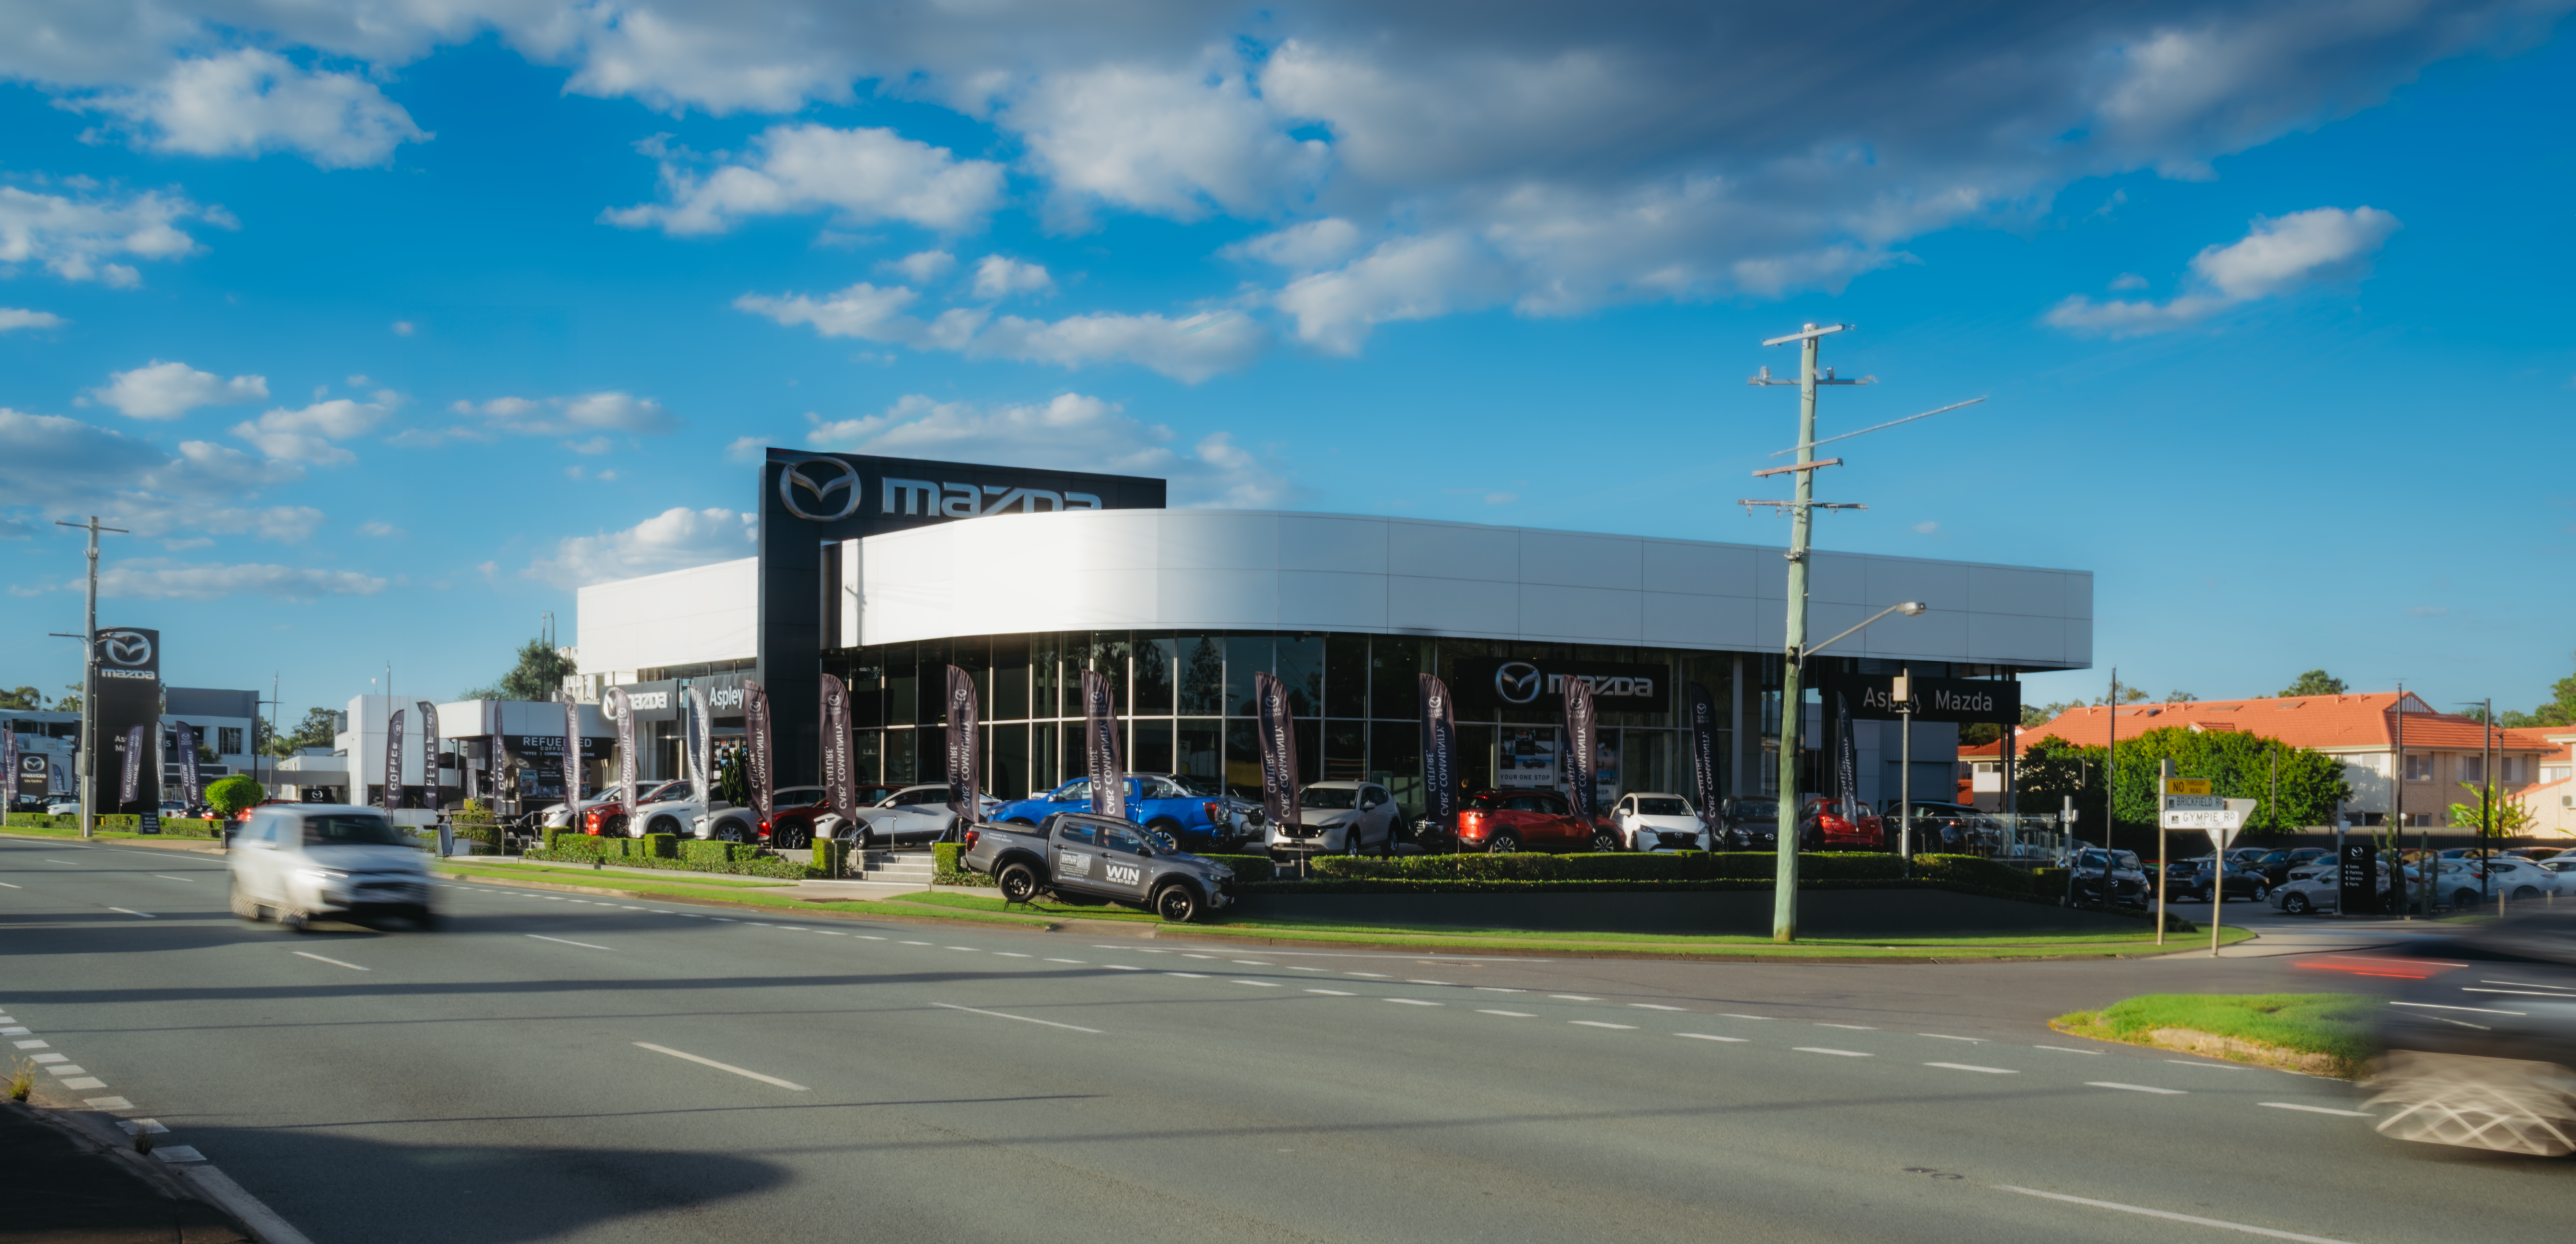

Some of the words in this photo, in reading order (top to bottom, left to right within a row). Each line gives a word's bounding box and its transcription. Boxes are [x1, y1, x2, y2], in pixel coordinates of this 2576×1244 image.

[709, 685, 745, 710] Aspley
[1935, 689, 1992, 712] Mazda
[2173, 781, 2184, 793] NO
[2177, 797, 2212, 807] BRICKFIELD
[2183, 812, 2218, 822] GYMPIE
[2224, 812, 2235, 822] RD
[1106, 864, 1140, 882] WIN
